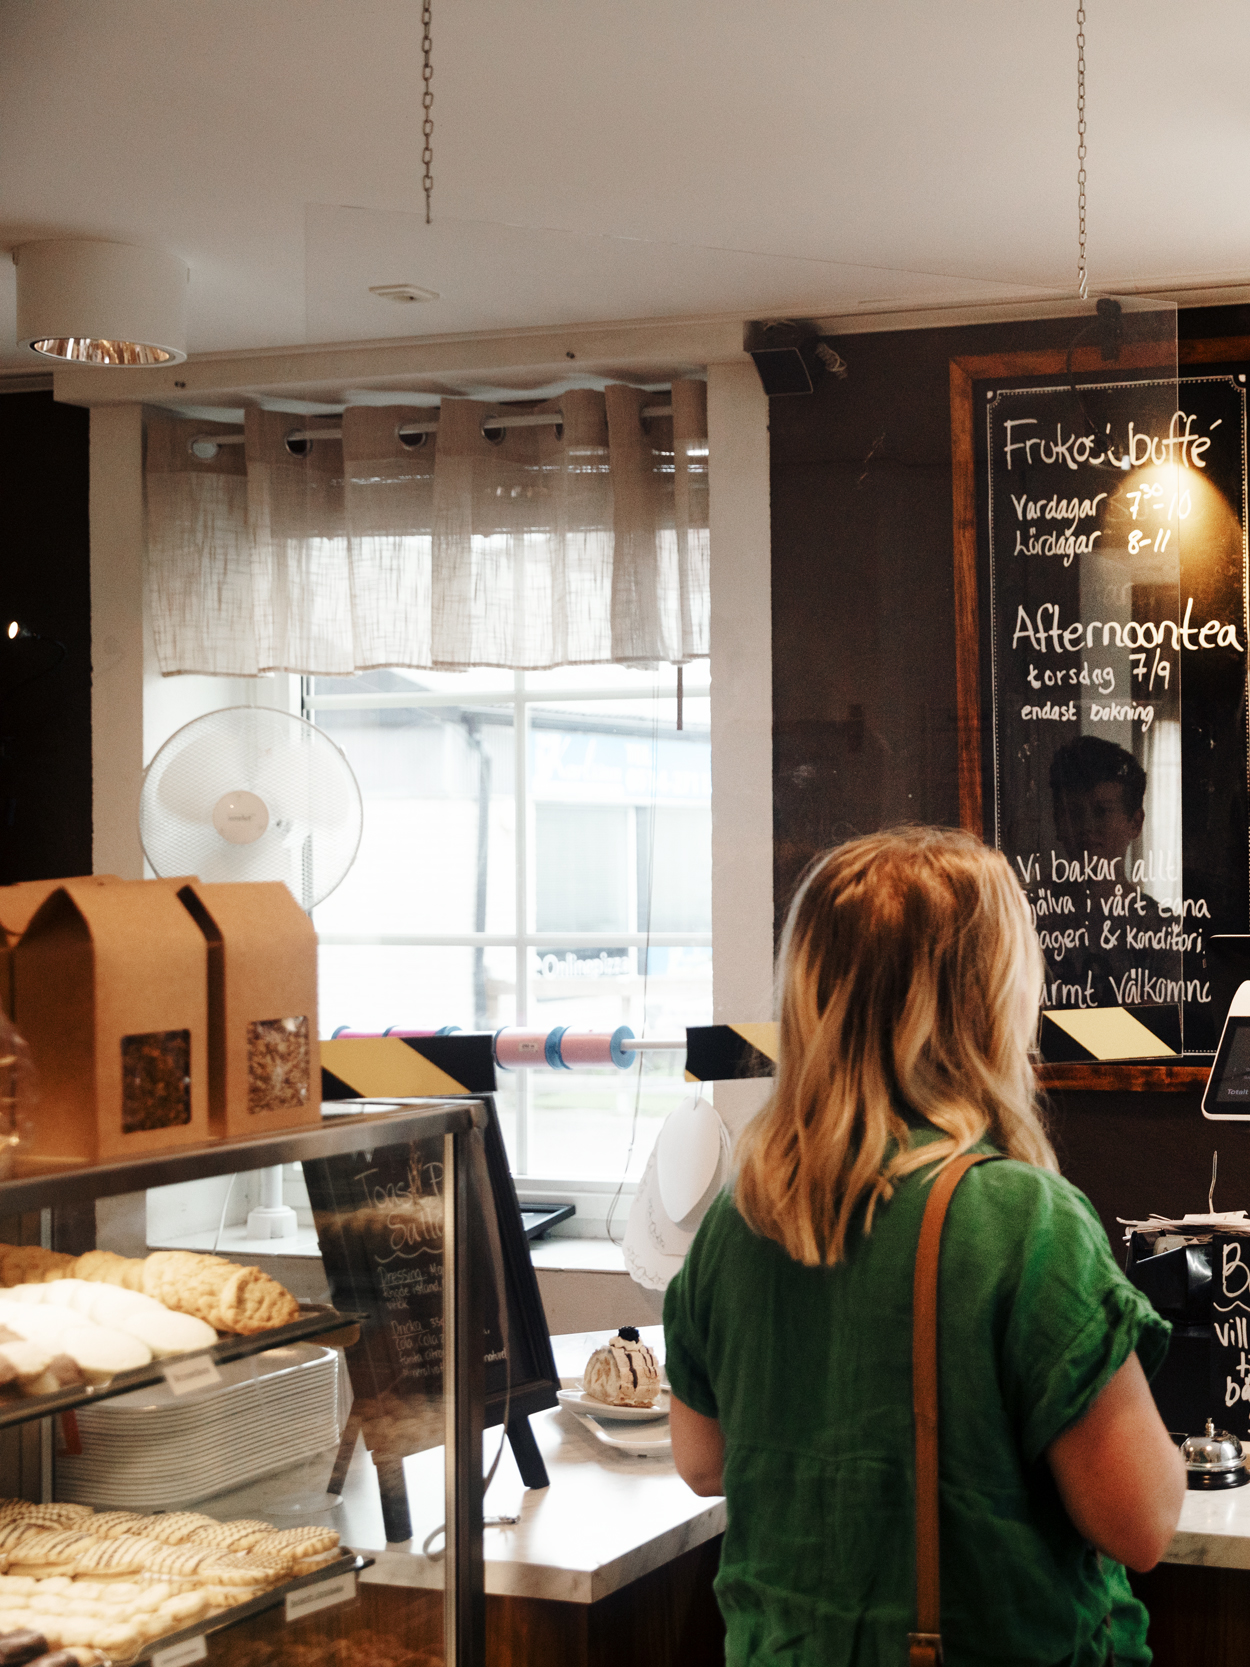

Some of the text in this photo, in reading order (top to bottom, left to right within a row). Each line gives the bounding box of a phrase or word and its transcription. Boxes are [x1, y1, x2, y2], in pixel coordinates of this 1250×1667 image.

[1011, 493, 1108, 533] Vardagar
[1014, 528, 1171, 567] Lördagar 8-11
[1012, 597, 1245, 654] Afternoontea
[1027, 648, 1171, 694] torsdag 7/9
[1021, 700, 1155, 731] endast bokning
[1016, 850, 1179, 883] Vi bakar allt
[1022, 888, 1076, 929] jälva
[1086, 889, 1092, 914] i
[1100, 884, 1147, 917] vårt
[1034, 921, 1089, 961] ageri
[1100, 921, 1121, 949] &
